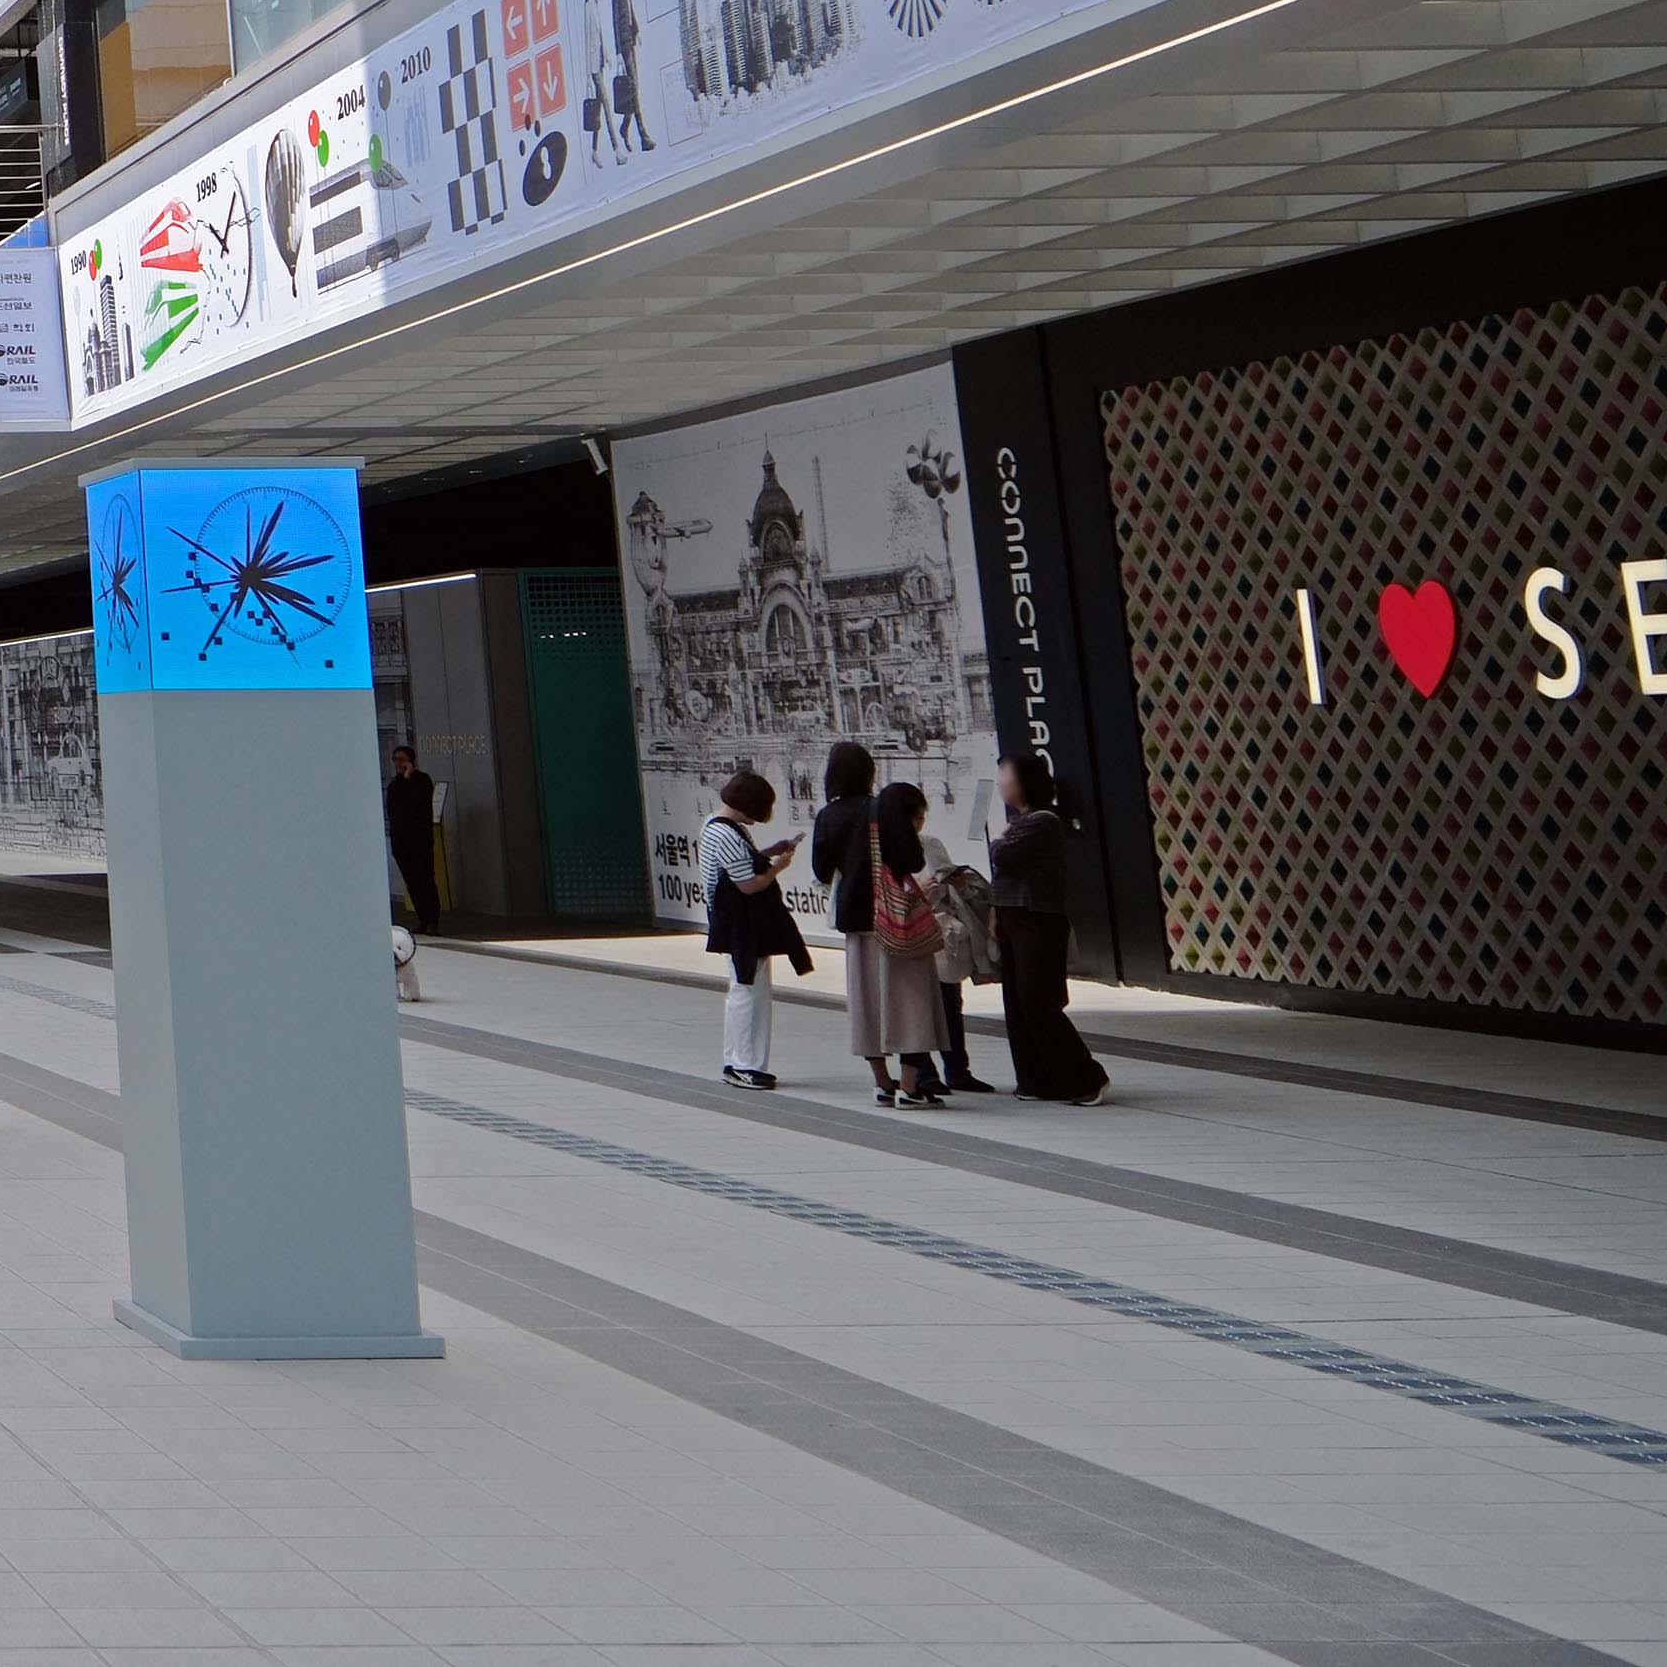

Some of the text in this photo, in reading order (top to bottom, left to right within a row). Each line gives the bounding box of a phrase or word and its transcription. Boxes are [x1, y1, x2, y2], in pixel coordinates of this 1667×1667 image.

[400, 45, 431, 85] 2010
[337, 85, 365, 118] 2004
[195, 175, 217, 203] 1998
[70, 254, 87, 276] 1990
[997, 447, 1055, 780] CONNECT PLAC
[1296, 558, 1667, 706] I SE
[655, 833, 691, 868] 서울역
[658, 874, 682, 902] 100
